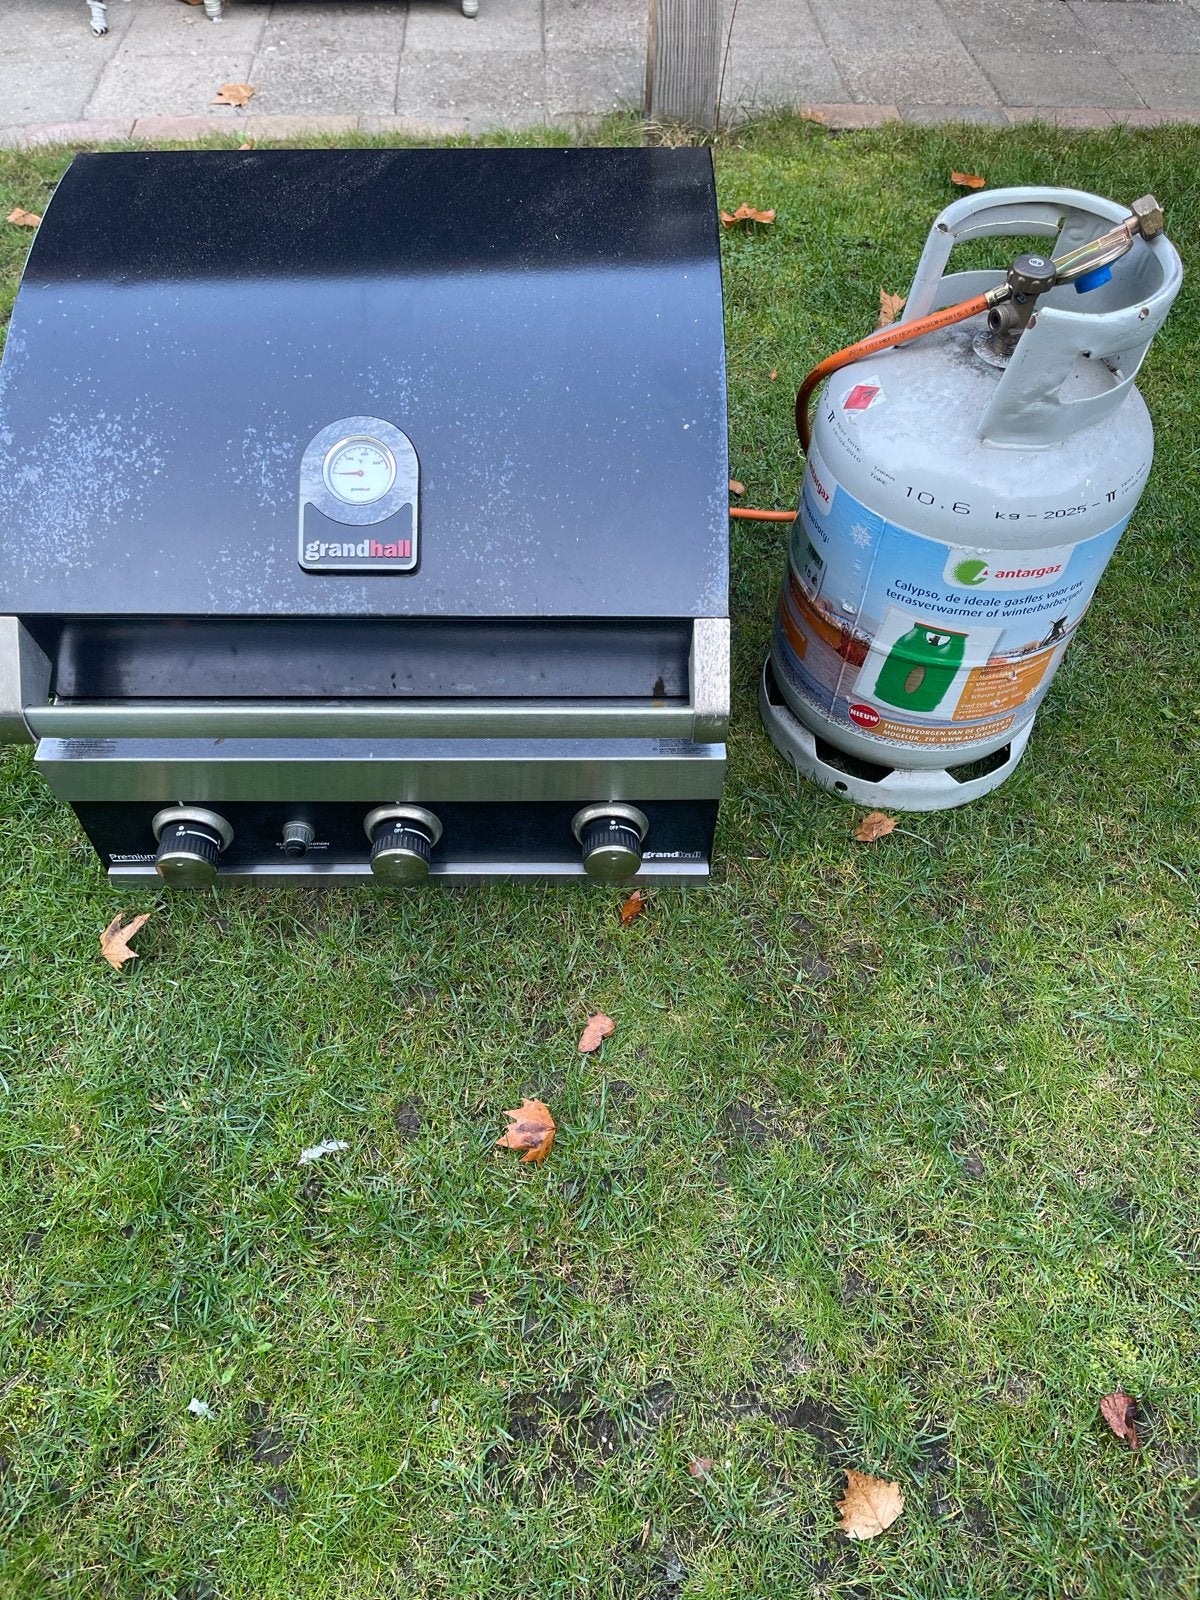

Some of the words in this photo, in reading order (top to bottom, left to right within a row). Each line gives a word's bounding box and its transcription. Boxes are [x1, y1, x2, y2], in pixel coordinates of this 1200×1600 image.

[905, 485, 971, 516] 10.6
[995, 510, 1021, 521] kg
[1043, 504, 1088, 520] 2025
[304, 539, 412, 561] grandhall
[994, 564, 1063, 579] antargaz
[894, 578, 942, 602] Calypso,
[945, 592, 961, 604] de
[963, 595, 1001, 608] ideale
[1003, 593, 1044, 608] gasfles
[1046, 585, 1069, 600] voor
[1069, 579, 1086, 592] uw
[886, 588, 982, 618] terrasverwarmer
[986, 608, 1000, 618] of
[849, 708, 880, 723] NIEUW
[883, 722, 946, 737] THUISBEZORGEN
[947, 729, 964, 737] VAN
[964, 728, 975, 736] DE
[108, 852, 157, 861] Premium
[642, 851, 702, 860] grandhall
